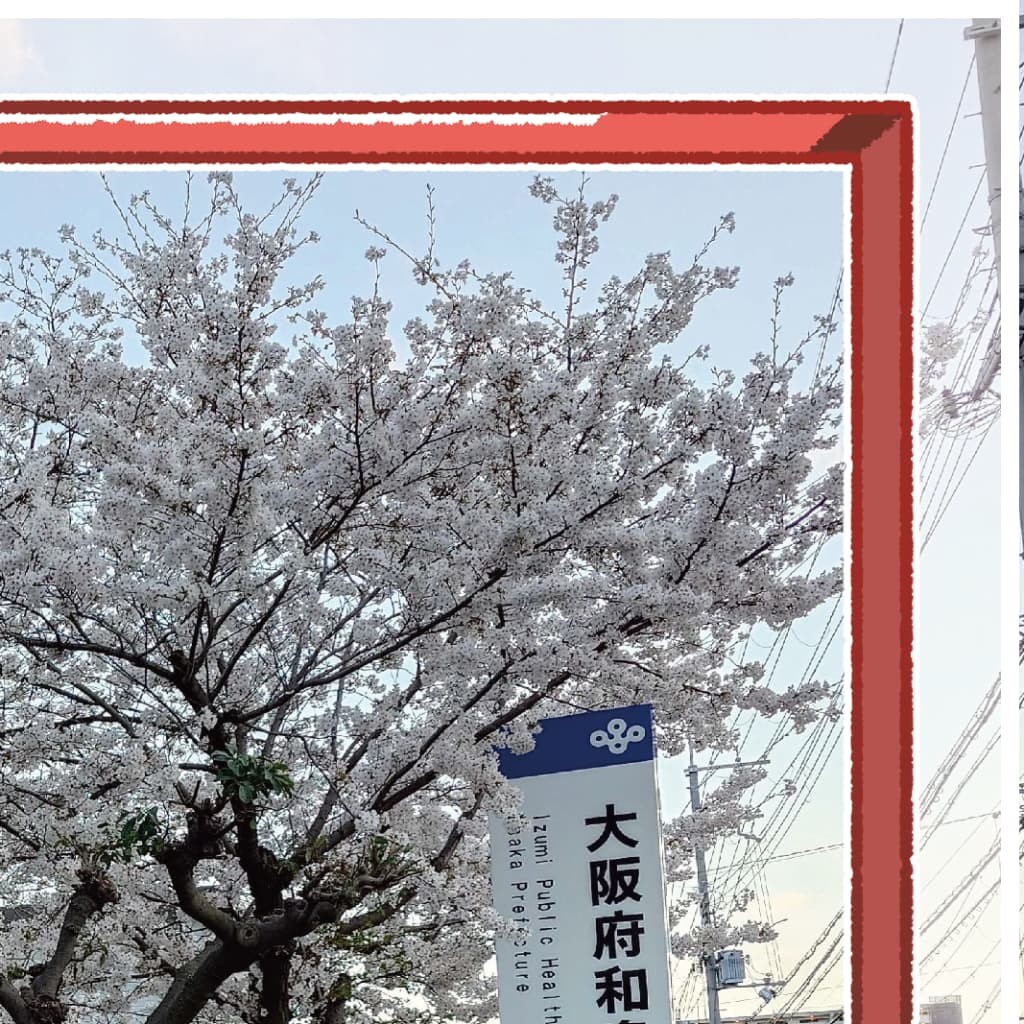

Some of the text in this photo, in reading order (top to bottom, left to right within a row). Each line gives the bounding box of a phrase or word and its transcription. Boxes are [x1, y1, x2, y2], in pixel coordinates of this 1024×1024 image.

[533, 814, 553, 864] Izumi
[536, 879, 557, 945] Public
[541, 958, 562, 1024] Health
